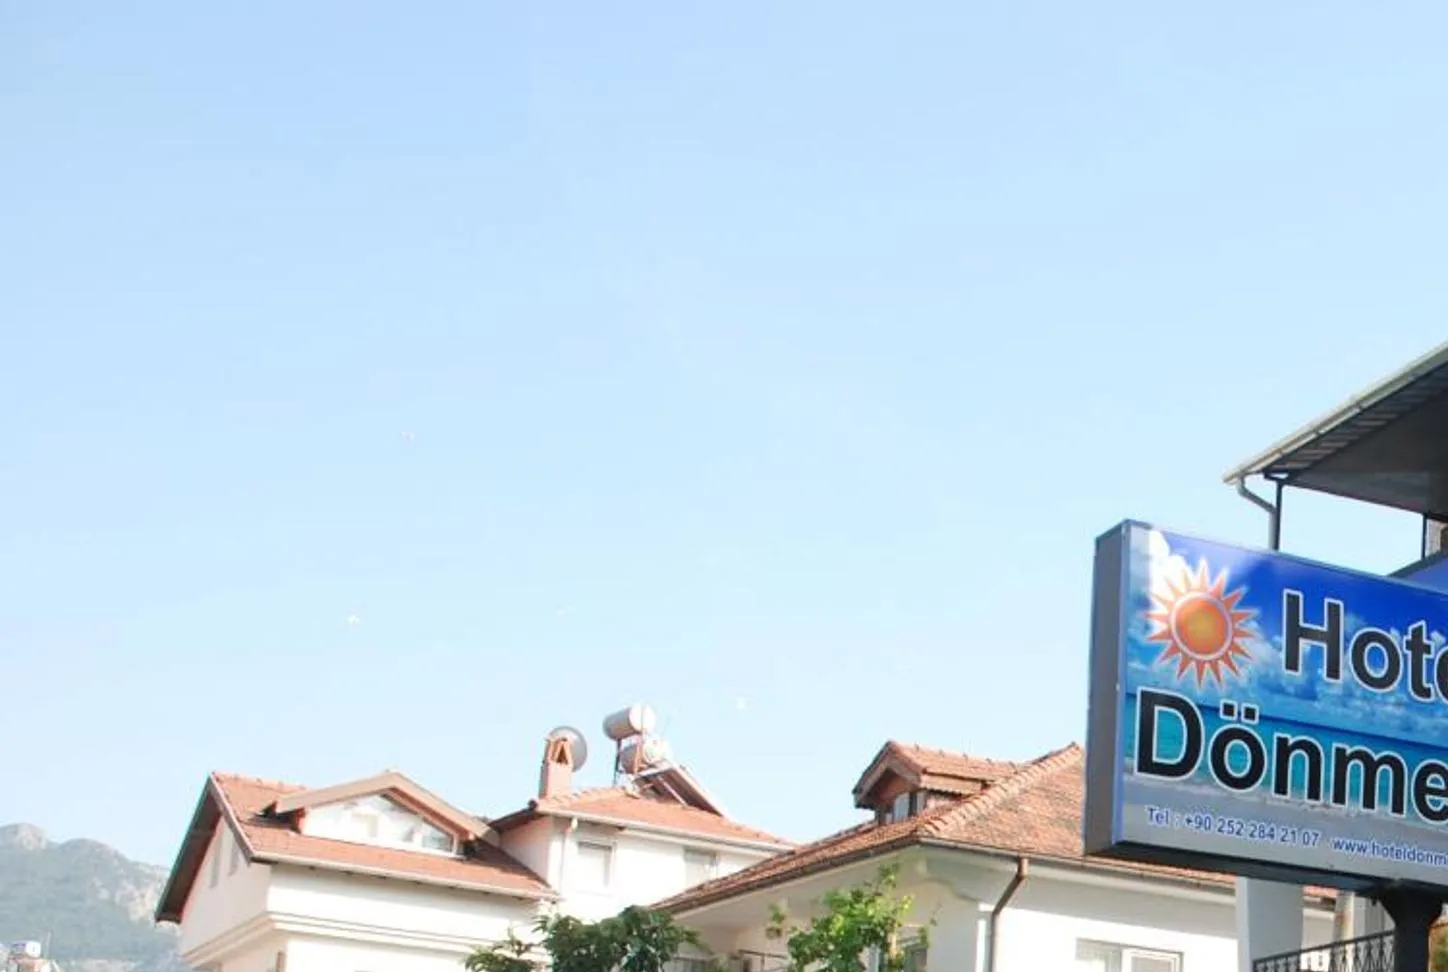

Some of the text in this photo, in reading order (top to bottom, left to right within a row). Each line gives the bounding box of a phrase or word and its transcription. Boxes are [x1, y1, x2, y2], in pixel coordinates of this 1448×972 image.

[1148, 807, 1169, 824] Tel
[1185, 814, 1211, 831] +90
[1217, 818, 1244, 836] 252
[1249, 823, 1275, 840] 284
[1281, 827, 1297, 843] 21
[1302, 831, 1320, 846] 07
